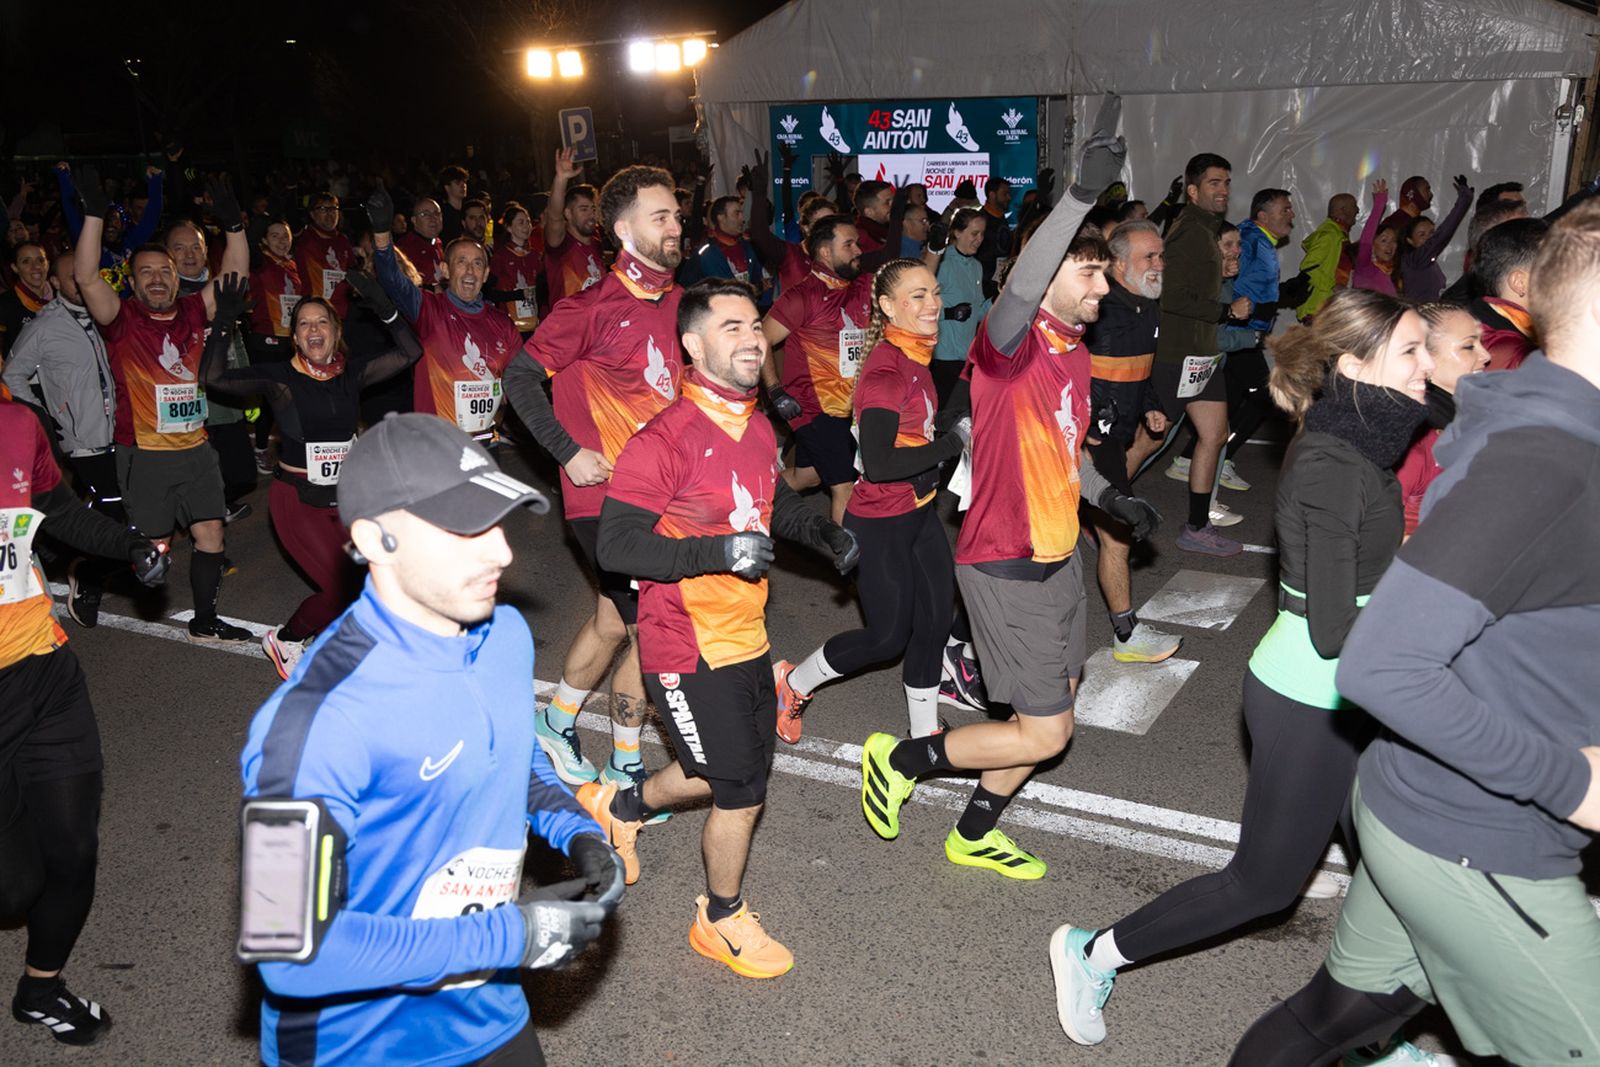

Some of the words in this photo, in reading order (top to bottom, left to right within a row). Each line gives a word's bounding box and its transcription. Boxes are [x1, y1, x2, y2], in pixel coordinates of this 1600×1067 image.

[867, 109, 892, 130] 43
[891, 108, 932, 128] SAN
[829, 132, 841, 147] 43
[863, 124, 929, 150] ANTÓN
[955, 129, 969, 145] 43
[925, 167, 946, 175] NOCHE
[924, 174, 955, 189] SAN
[473, 361, 487, 376] 43
[655, 373, 670, 393] 43
[169, 401, 202, 418] 8024
[470, 398, 494, 415] 909
[665, 690, 708, 765] SPARTAN
[439, 881, 473, 897] SAN
